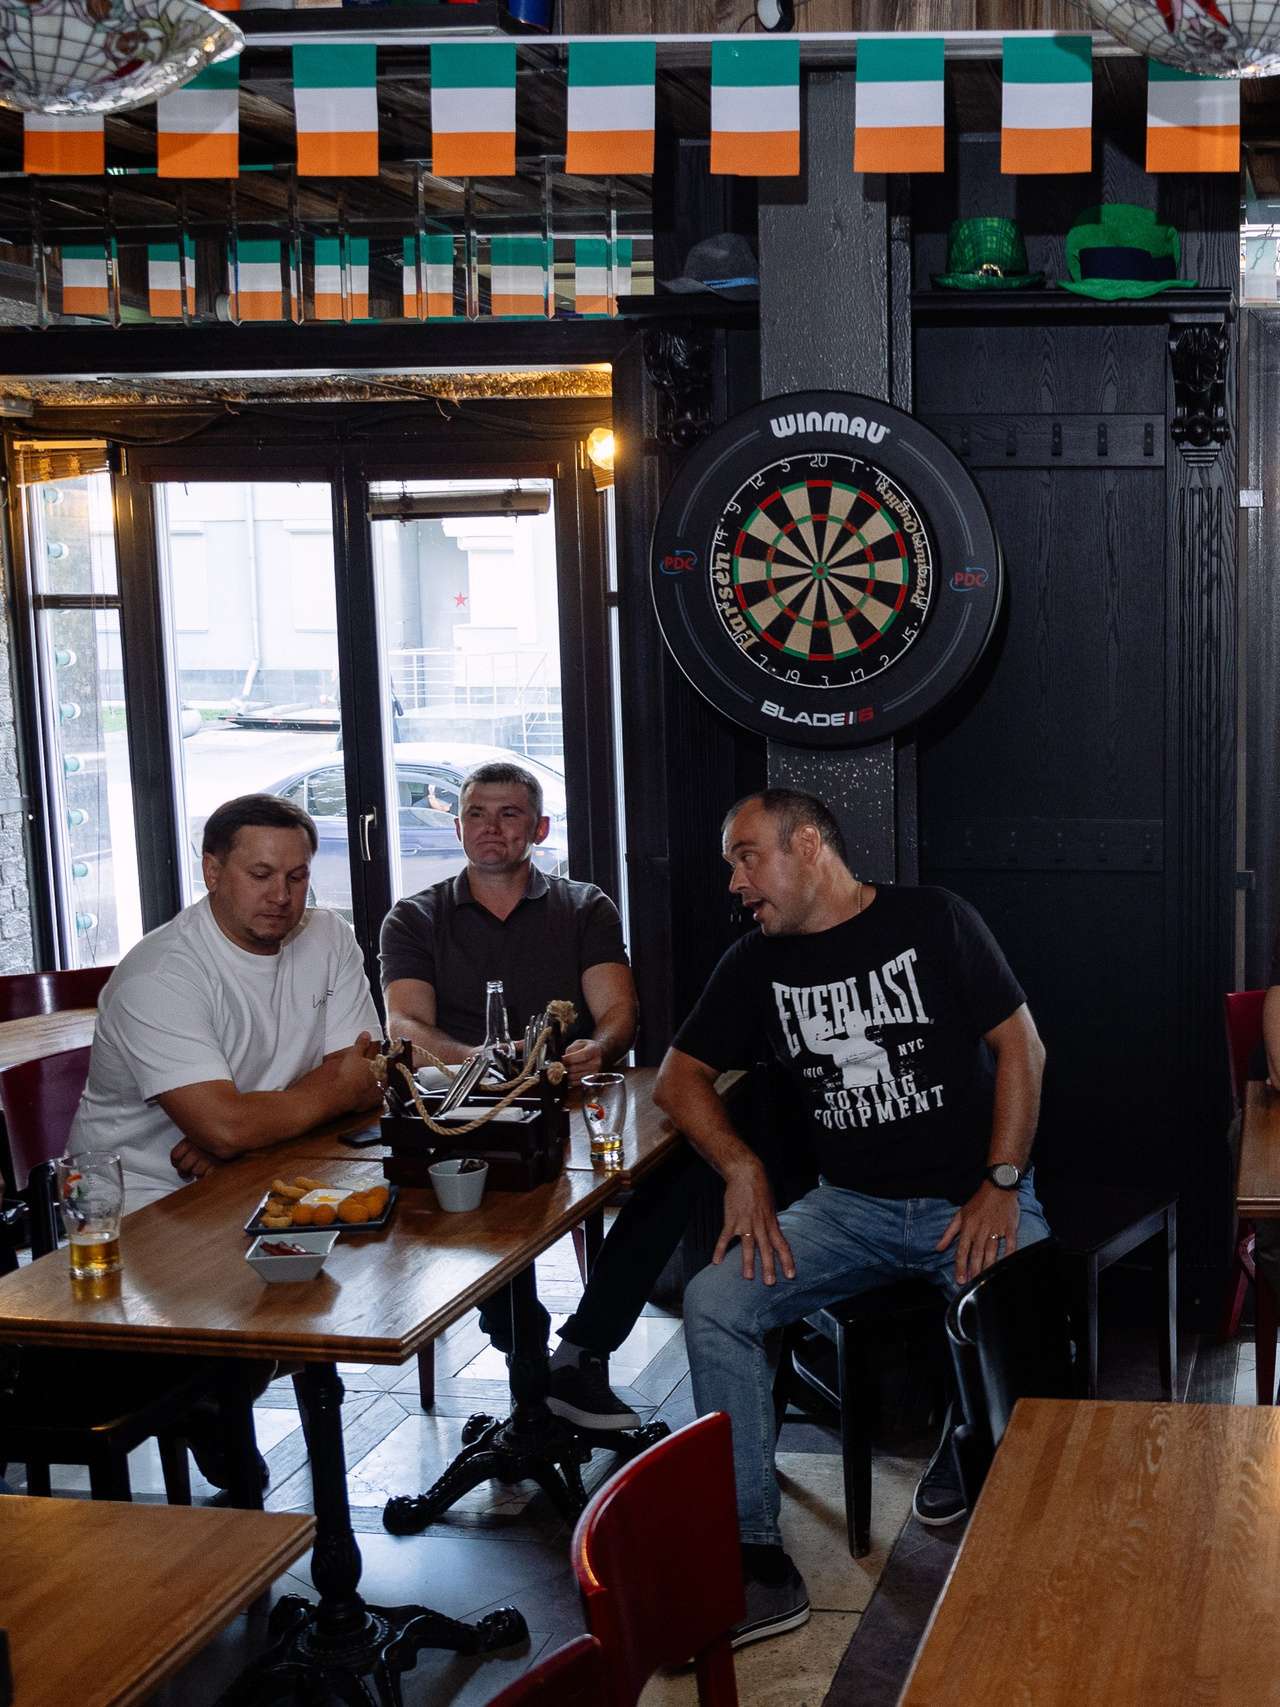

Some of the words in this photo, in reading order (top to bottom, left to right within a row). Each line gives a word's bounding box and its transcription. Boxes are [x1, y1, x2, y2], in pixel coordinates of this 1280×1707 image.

[770, 411, 887, 443] WINMAU
[808, 453, 828, 468] 20
[747, 473, 766, 490] 12
[714, 528, 729, 547] 14
[664, 556, 696, 571] PDC
[954, 571, 986, 588] PDC
[715, 552, 760, 652] Larsen
[902, 626, 918, 643] 15
[785, 669, 800, 684] 19
[850, 668, 866, 684] 17
[761, 700, 847, 727] BLADE
[772, 948, 929, 1058] EVERLAST
[897, 1038, 925, 1057] NYC
[824, 1074, 918, 1111] BOXING
[814, 1084, 945, 1130] EQUIPMENT
